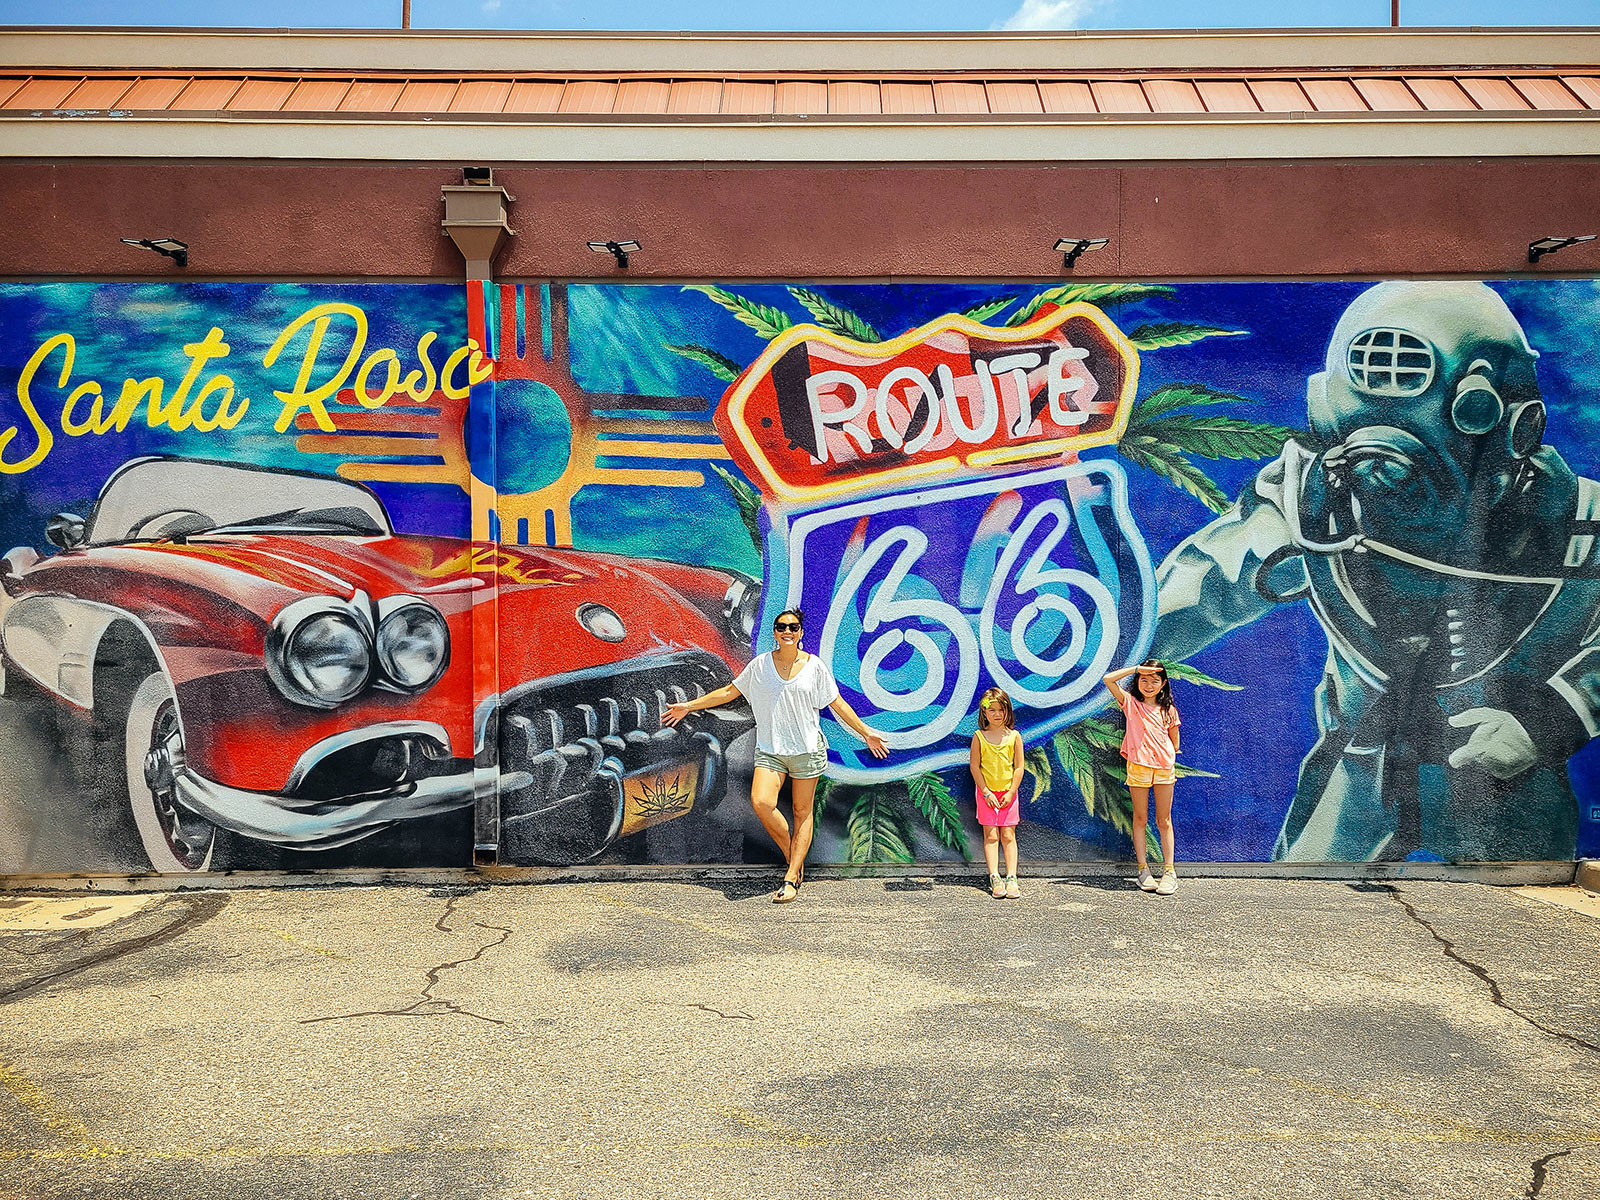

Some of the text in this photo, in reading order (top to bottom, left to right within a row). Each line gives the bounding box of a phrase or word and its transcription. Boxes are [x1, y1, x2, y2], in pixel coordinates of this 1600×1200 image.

[0, 303, 494, 474] Santa Rosa
[804, 347, 1091, 462] ROUTE
[819, 498, 1119, 749] 66
